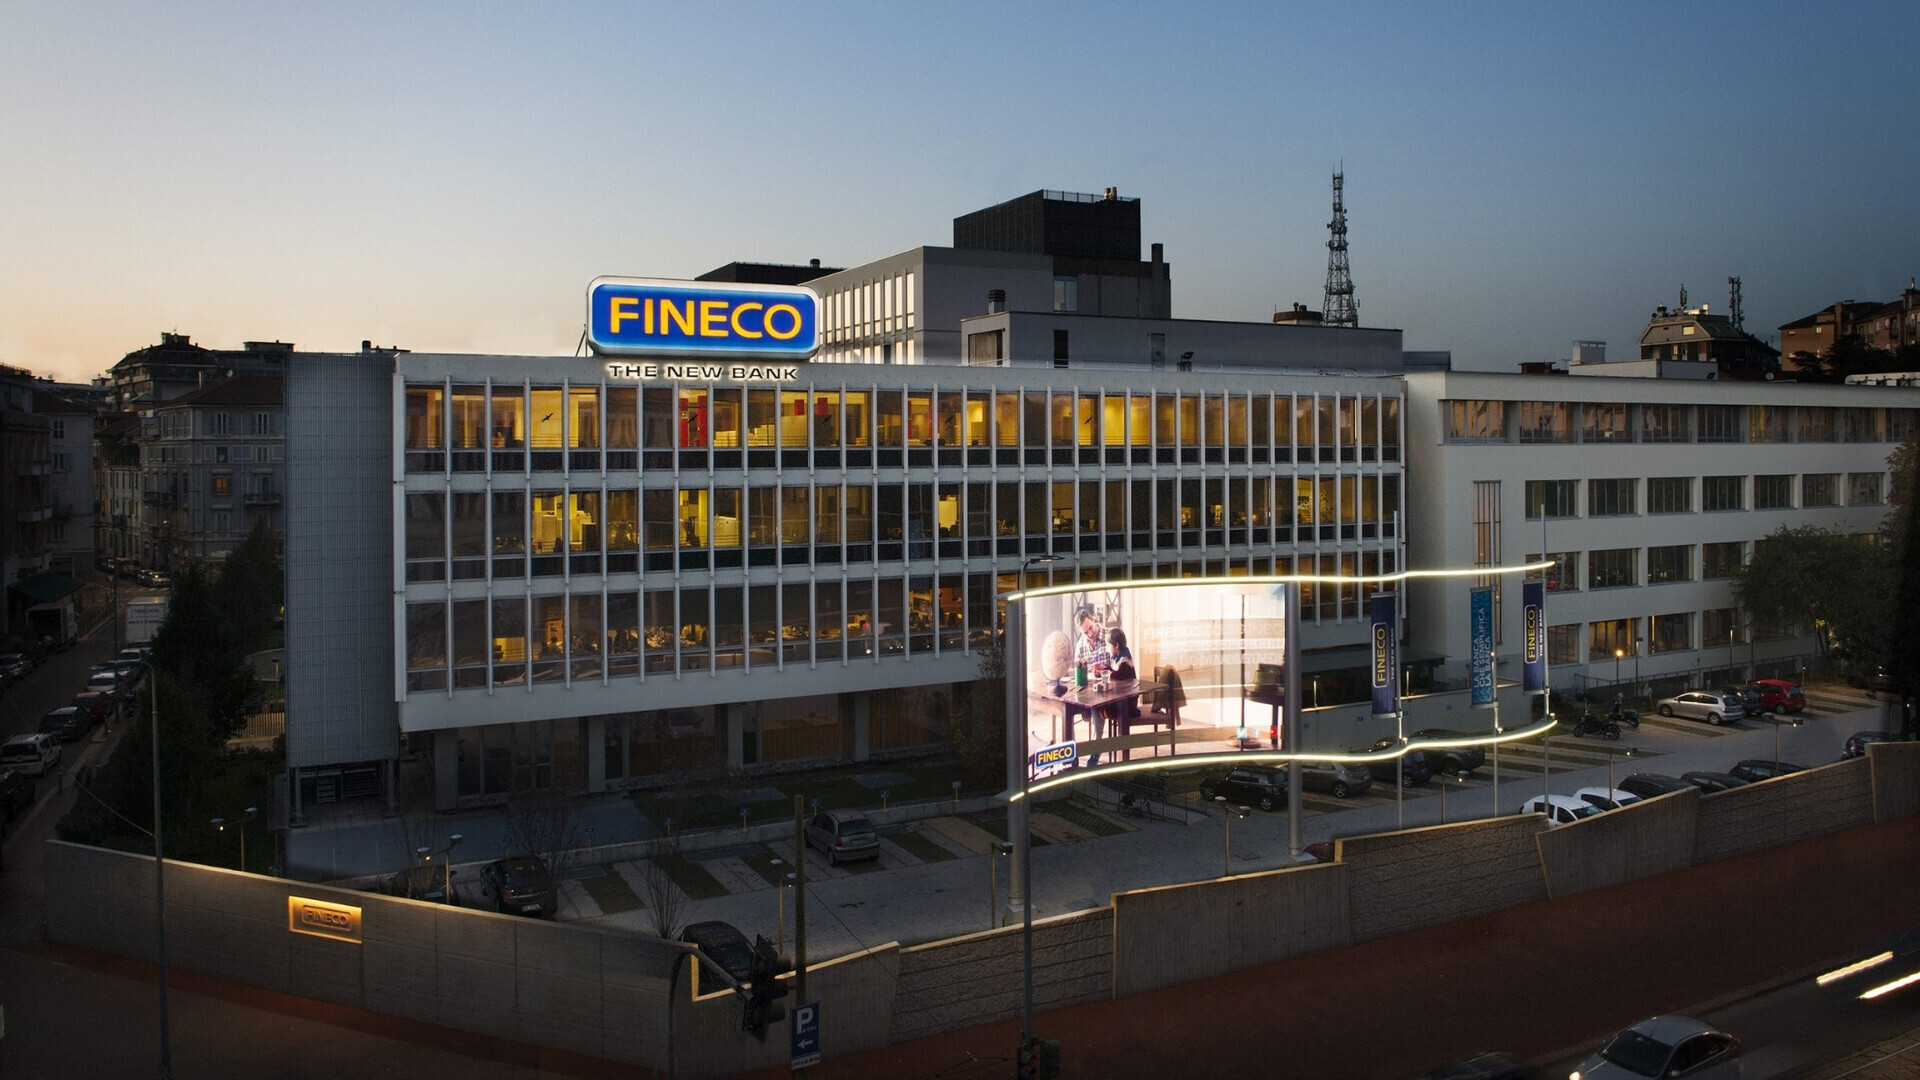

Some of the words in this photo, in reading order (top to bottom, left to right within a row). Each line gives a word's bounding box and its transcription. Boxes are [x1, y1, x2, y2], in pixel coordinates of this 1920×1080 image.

[610, 296, 802, 340] FINECO
[609, 365, 657, 377] THE
[667, 366, 722, 378] NEW
[732, 367, 797, 380] BANK
[1527, 609, 1536, 659] FINECO
[1377, 628, 1386, 682] FINECO
[1473, 675, 1480, 688] LA
[1485, 673, 1492, 687] LA
[1038, 746, 1073, 764] FINECO
[306, 910, 348, 926] FINECO
[796, 1007, 814, 1035] P
